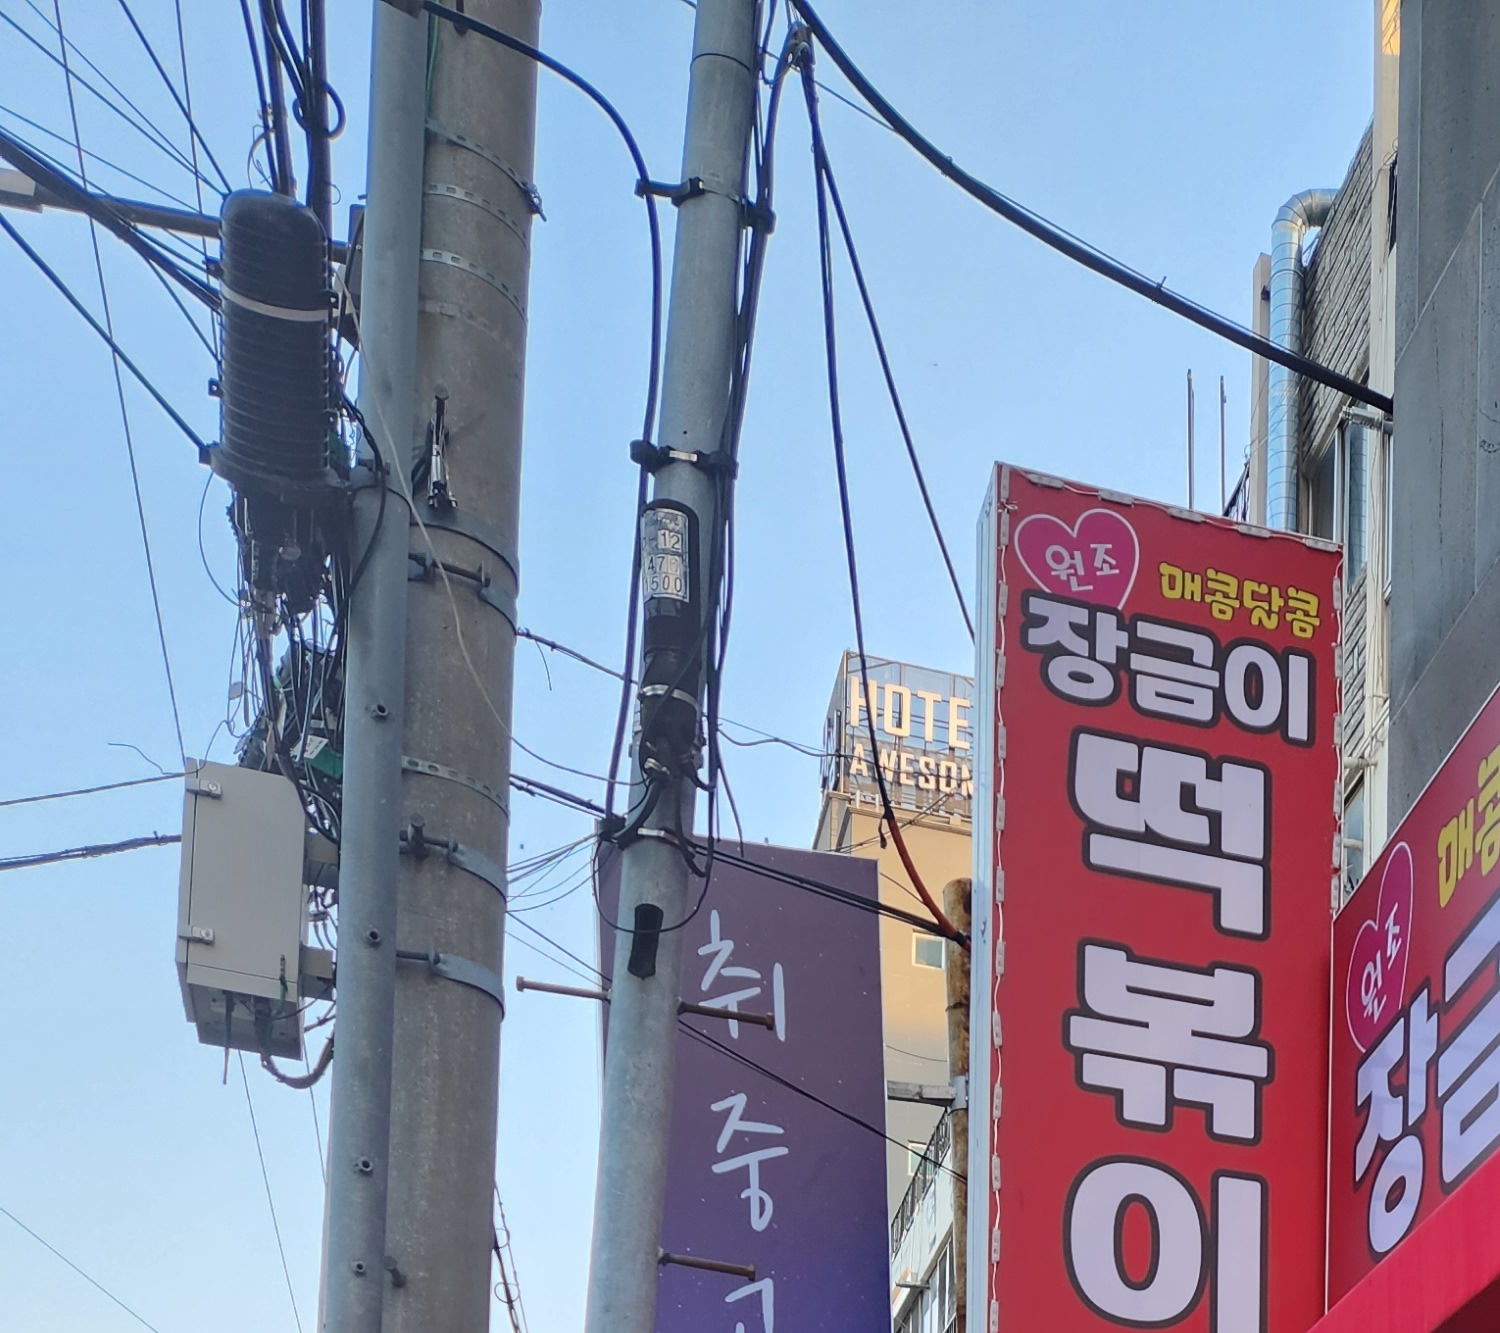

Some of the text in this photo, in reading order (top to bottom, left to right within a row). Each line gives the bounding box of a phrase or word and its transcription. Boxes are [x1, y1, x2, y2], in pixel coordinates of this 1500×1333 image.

[1046, 542, 1120, 592] 원조
[849, 675, 971, 751] HOTE
[1022, 590, 1314, 745] 장금이
[1361, 902, 1403, 1025] 원조
